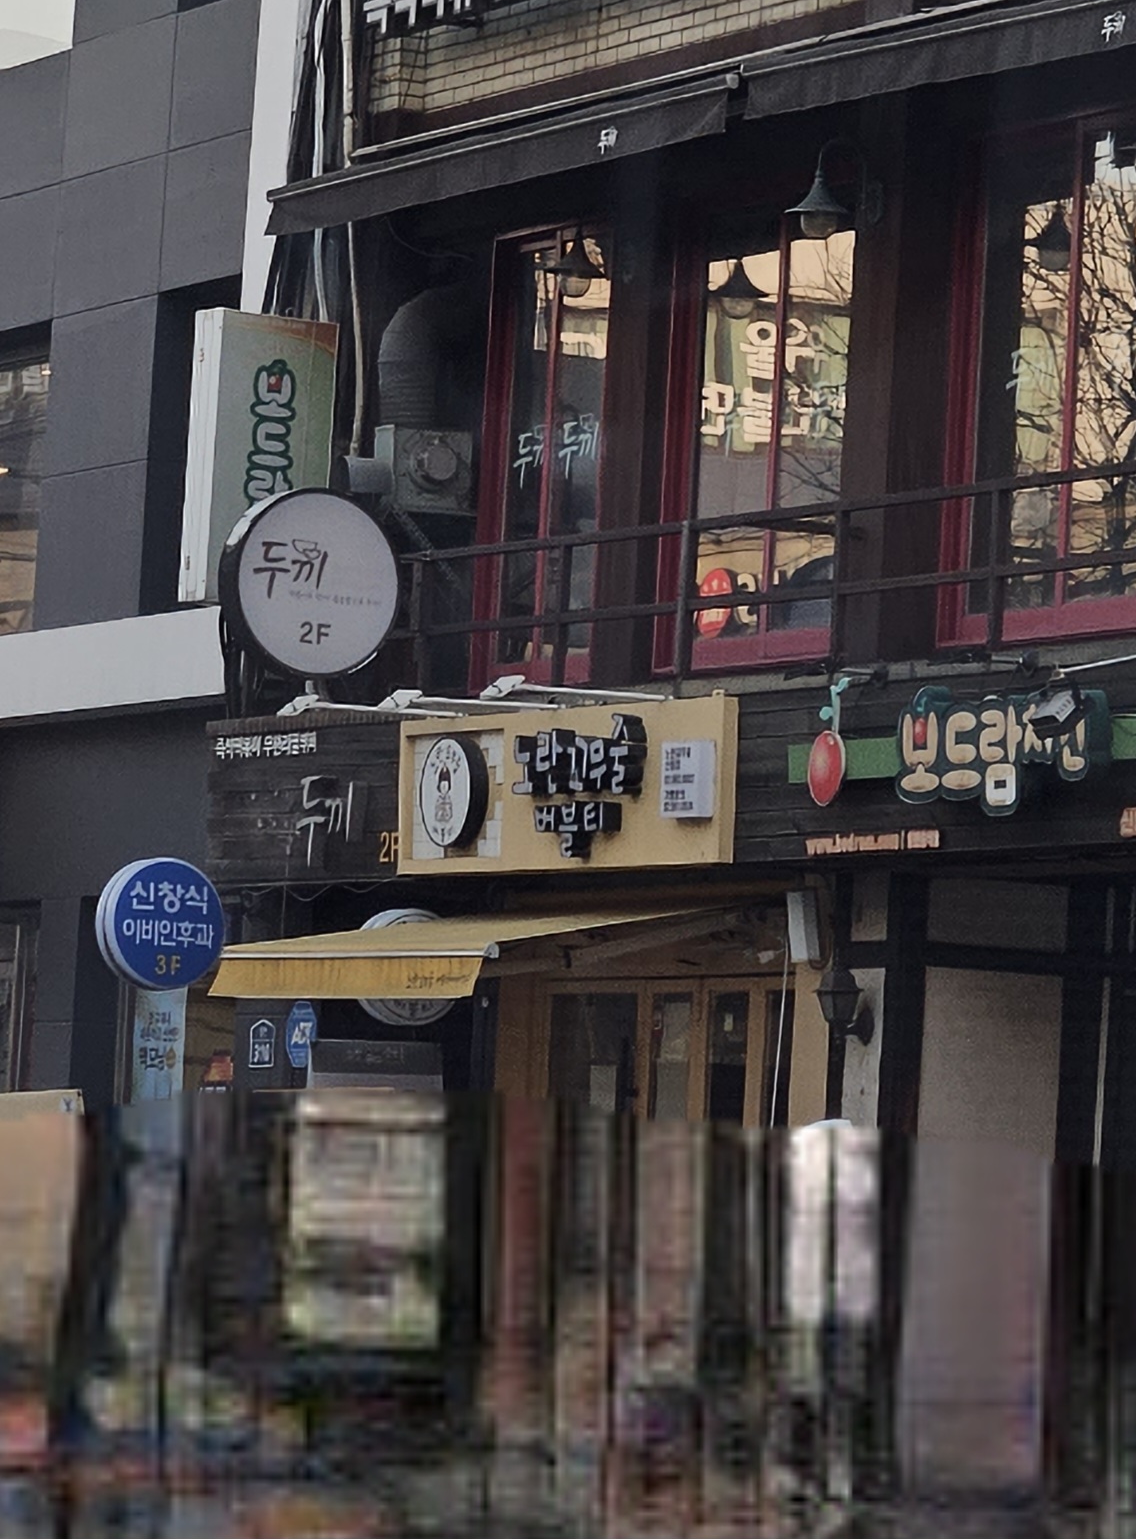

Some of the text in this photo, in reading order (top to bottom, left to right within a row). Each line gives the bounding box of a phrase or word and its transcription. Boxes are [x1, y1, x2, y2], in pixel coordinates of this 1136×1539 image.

[253, 540, 329, 600] 두끼
[298, 620, 332, 646] 2F
[129, 880, 208, 915] 신창식
[123, 919, 215, 949] 이비인후과
[154, 954, 181, 976] 3F
